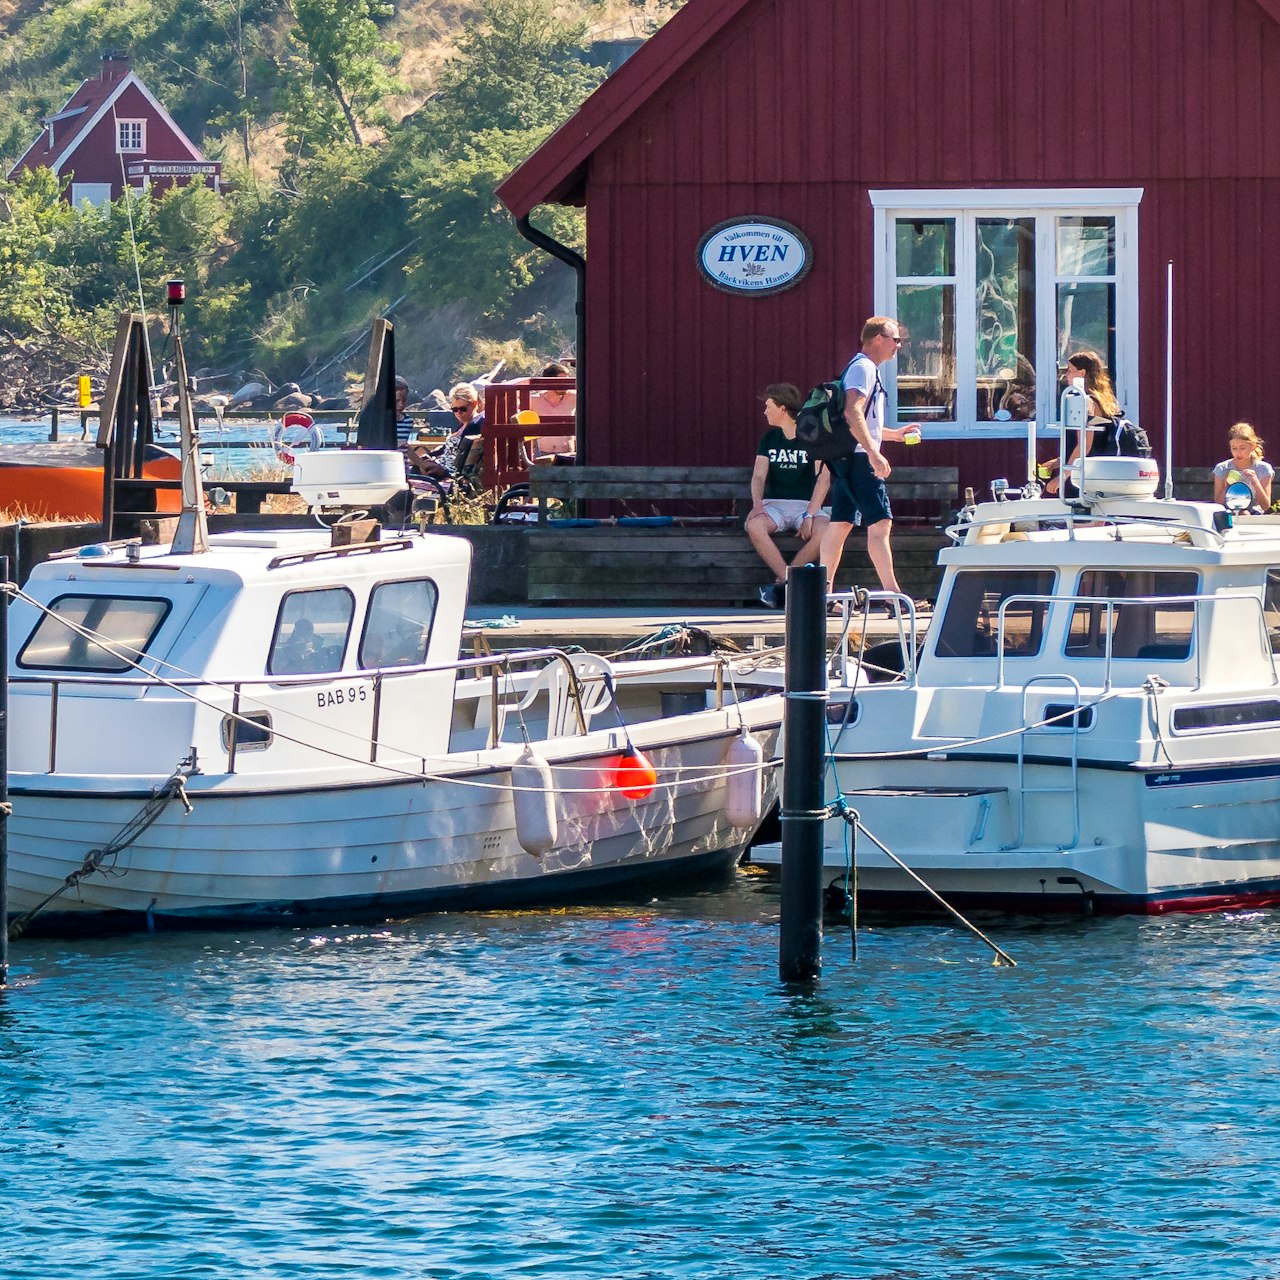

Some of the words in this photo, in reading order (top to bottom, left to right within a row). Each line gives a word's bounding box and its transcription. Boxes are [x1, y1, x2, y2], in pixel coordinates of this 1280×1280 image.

[723, 231, 770, 241] Välkommen
[771, 233, 784, 243] till
[718, 245, 789, 262] HVEN
[768, 449, 808, 464] GANT
[317, 689, 345, 708] BAB
[348, 686, 367, 703] 95
